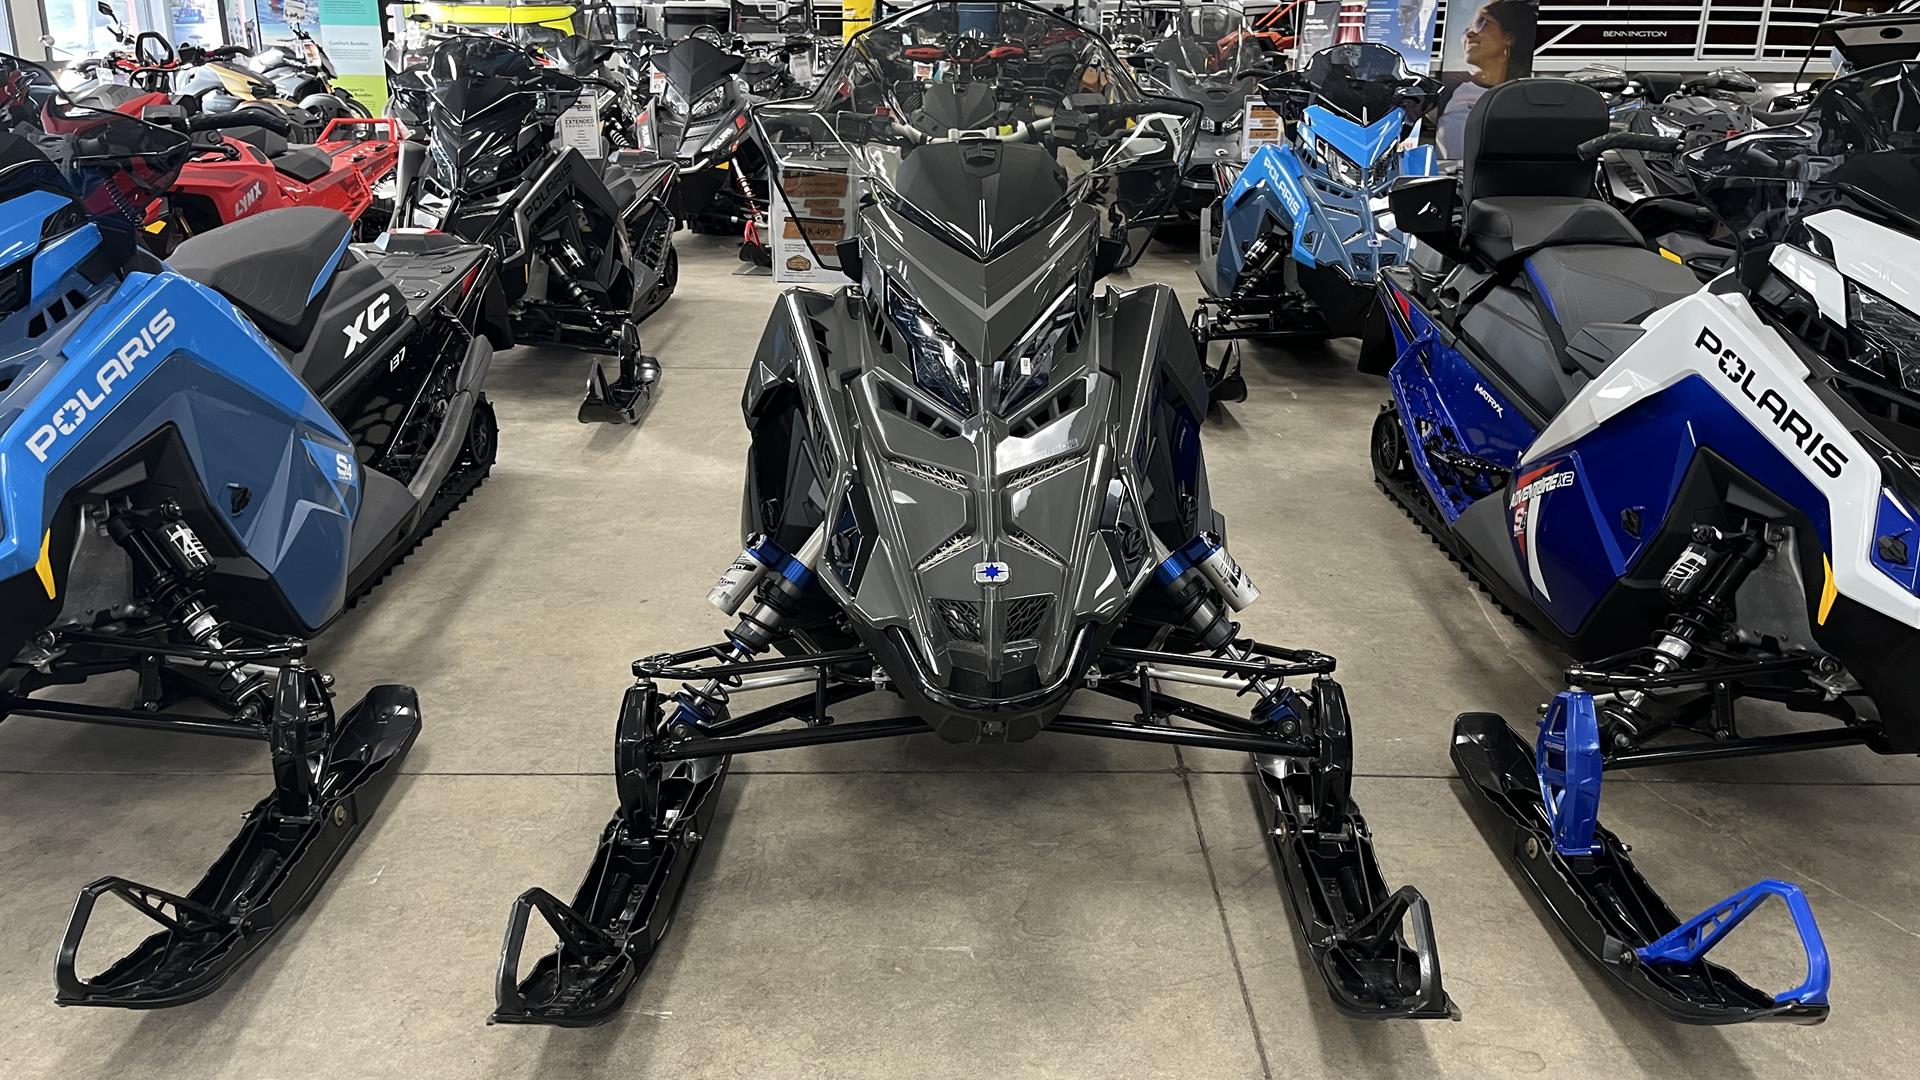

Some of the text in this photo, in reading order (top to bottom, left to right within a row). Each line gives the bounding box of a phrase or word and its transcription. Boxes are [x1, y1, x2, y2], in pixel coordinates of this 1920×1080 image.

[1603, 30, 1667, 38] BENNINGTON
[711, 127, 734, 150] POLARIS
[235, 181, 262, 217] LYNX
[524, 159, 572, 221] POLARIS
[1263, 156, 1301, 216] POLARIS
[342, 293, 390, 360] XC
[390, 346, 406, 373] 137
[25, 308, 176, 463] POLARIS
[1474, 383, 1504, 418] MATRYX
[1694, 326, 1850, 479] POLARIS
[1509, 471, 1575, 510] ADVENTURE X2
